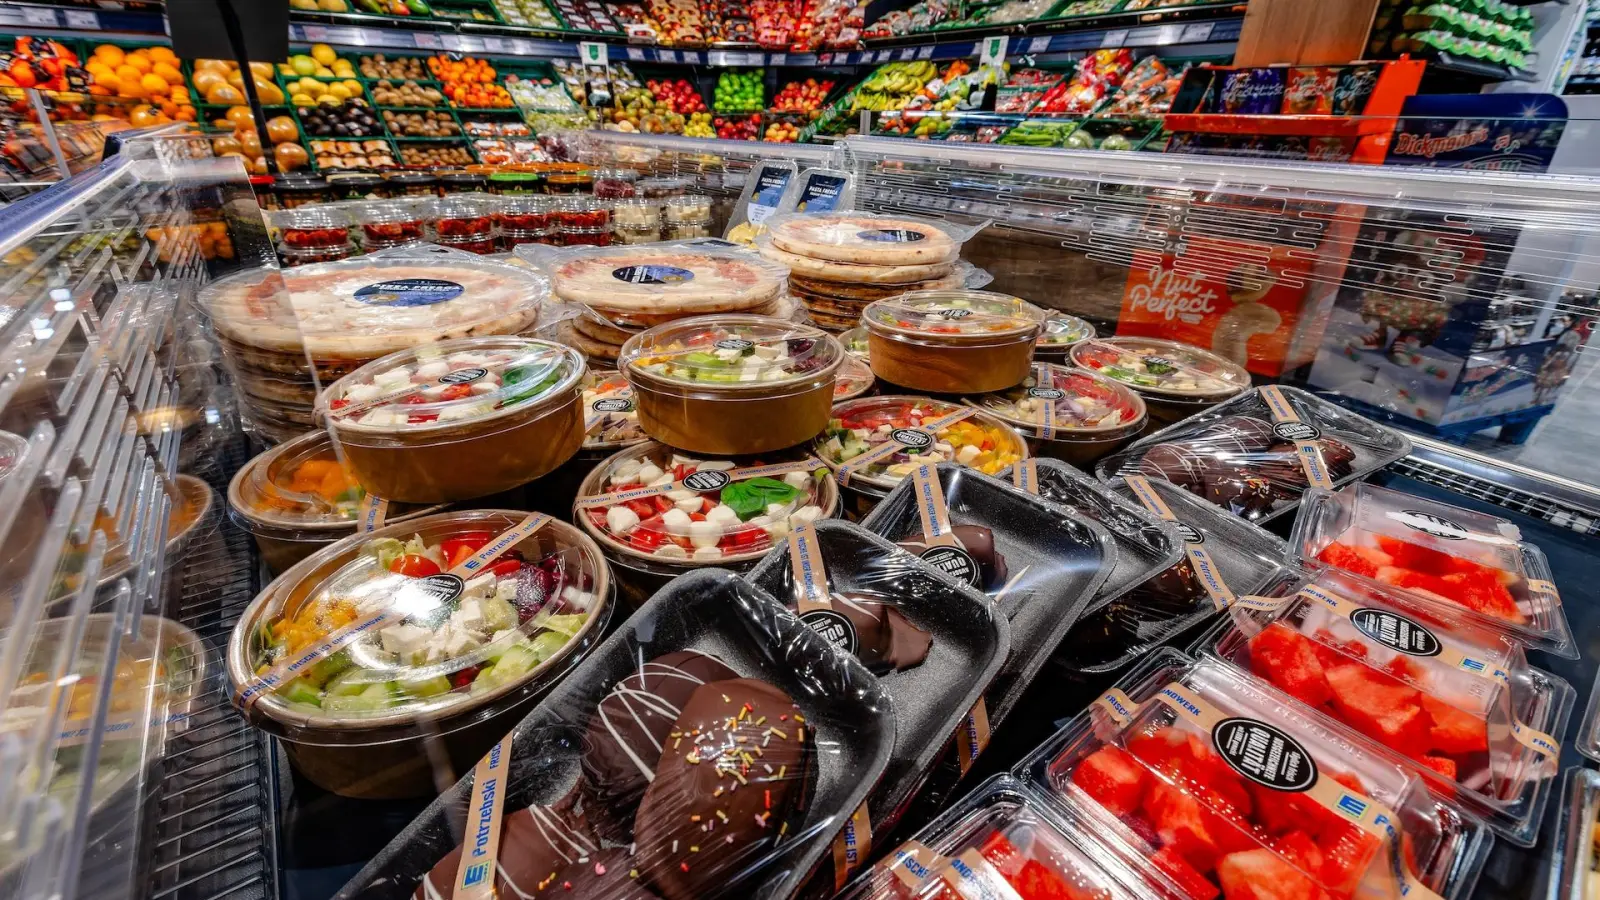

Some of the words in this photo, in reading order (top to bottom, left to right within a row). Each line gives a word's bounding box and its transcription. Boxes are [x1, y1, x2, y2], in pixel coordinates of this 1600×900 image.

[1149, 264, 1207, 297] Nut
[1130, 283, 1219, 321] Perfect
[480, 532, 520, 560] Potrzebski
[1379, 614, 1399, 646] QUALITÄT
[1241, 727, 1271, 775] QUALITÄT
[1263, 736, 1285, 781] AUSGEZEICHNETE
[471, 778, 497, 858] Potrzebski
